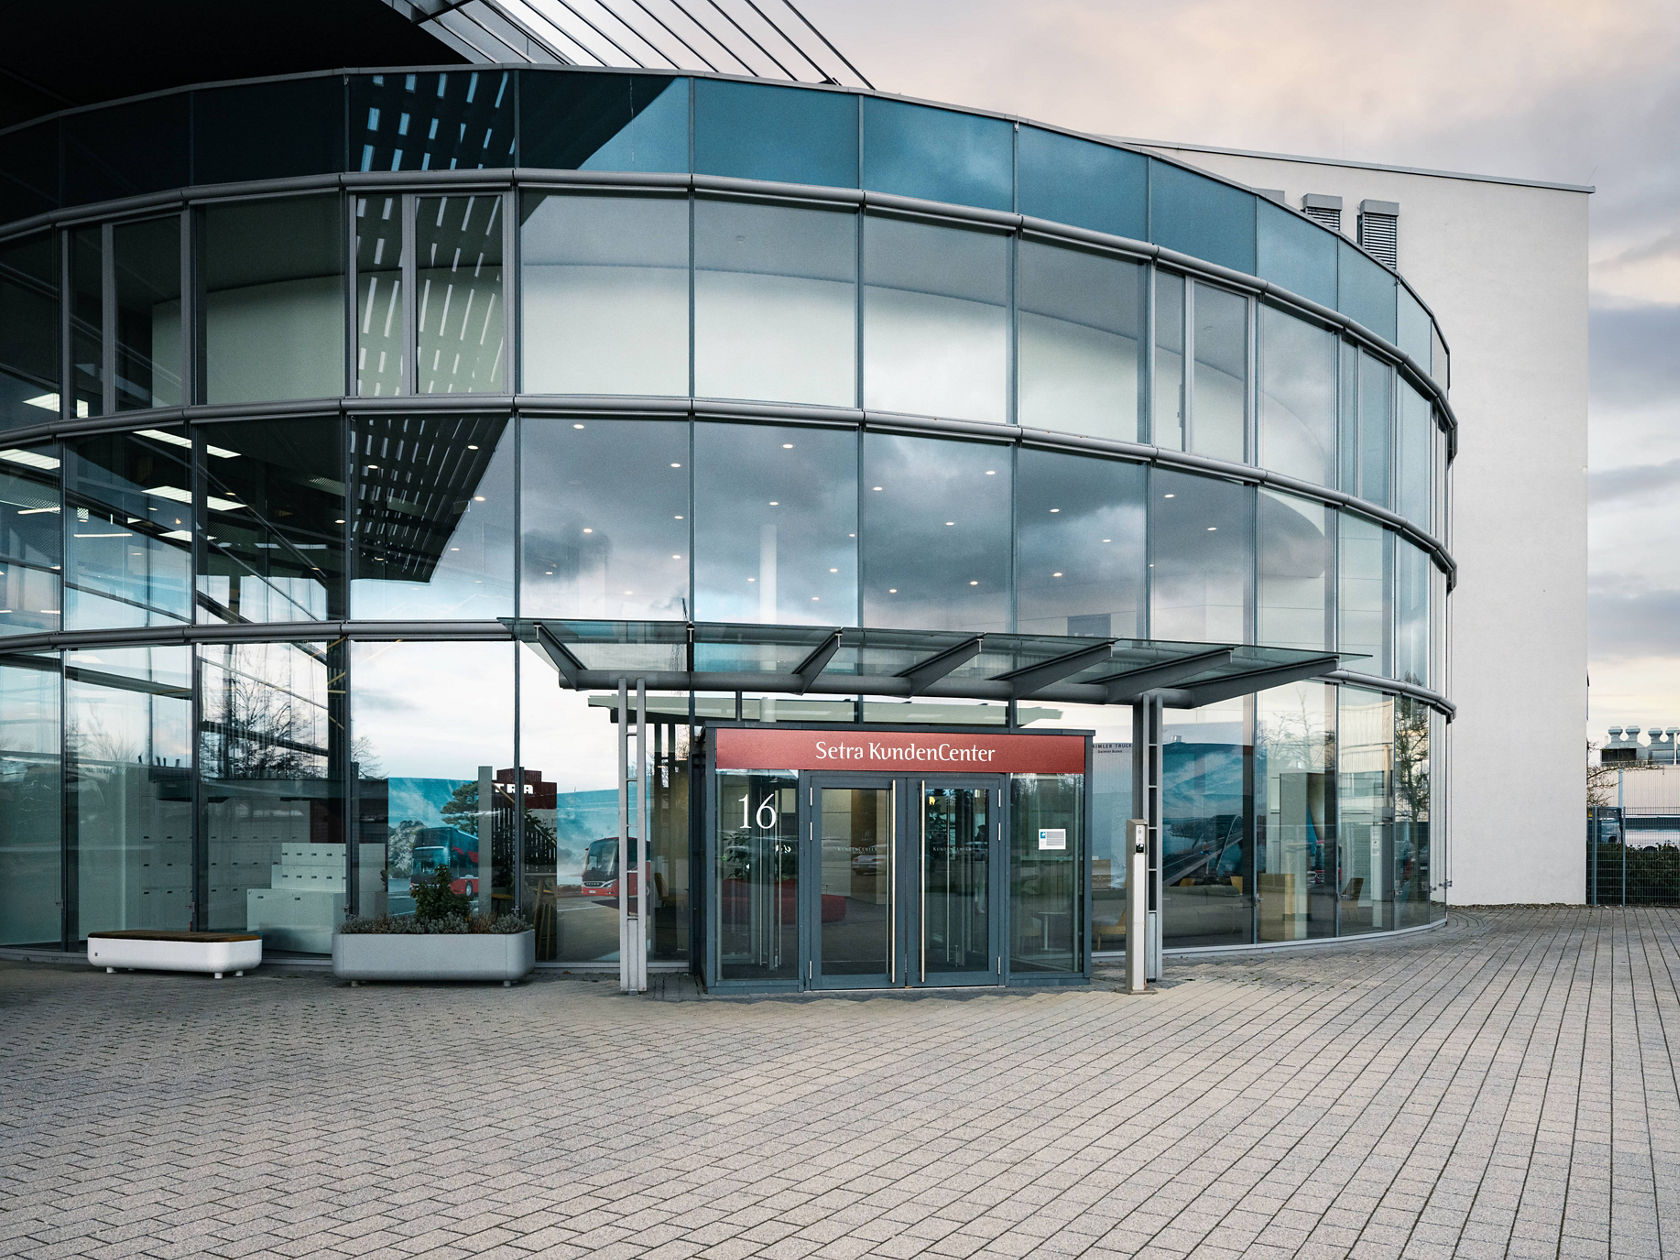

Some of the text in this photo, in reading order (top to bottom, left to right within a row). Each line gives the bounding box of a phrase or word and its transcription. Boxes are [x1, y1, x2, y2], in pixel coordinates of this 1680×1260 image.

[815, 741, 996, 762] Setra KundenCenter
[738, 793, 777, 829] 16
